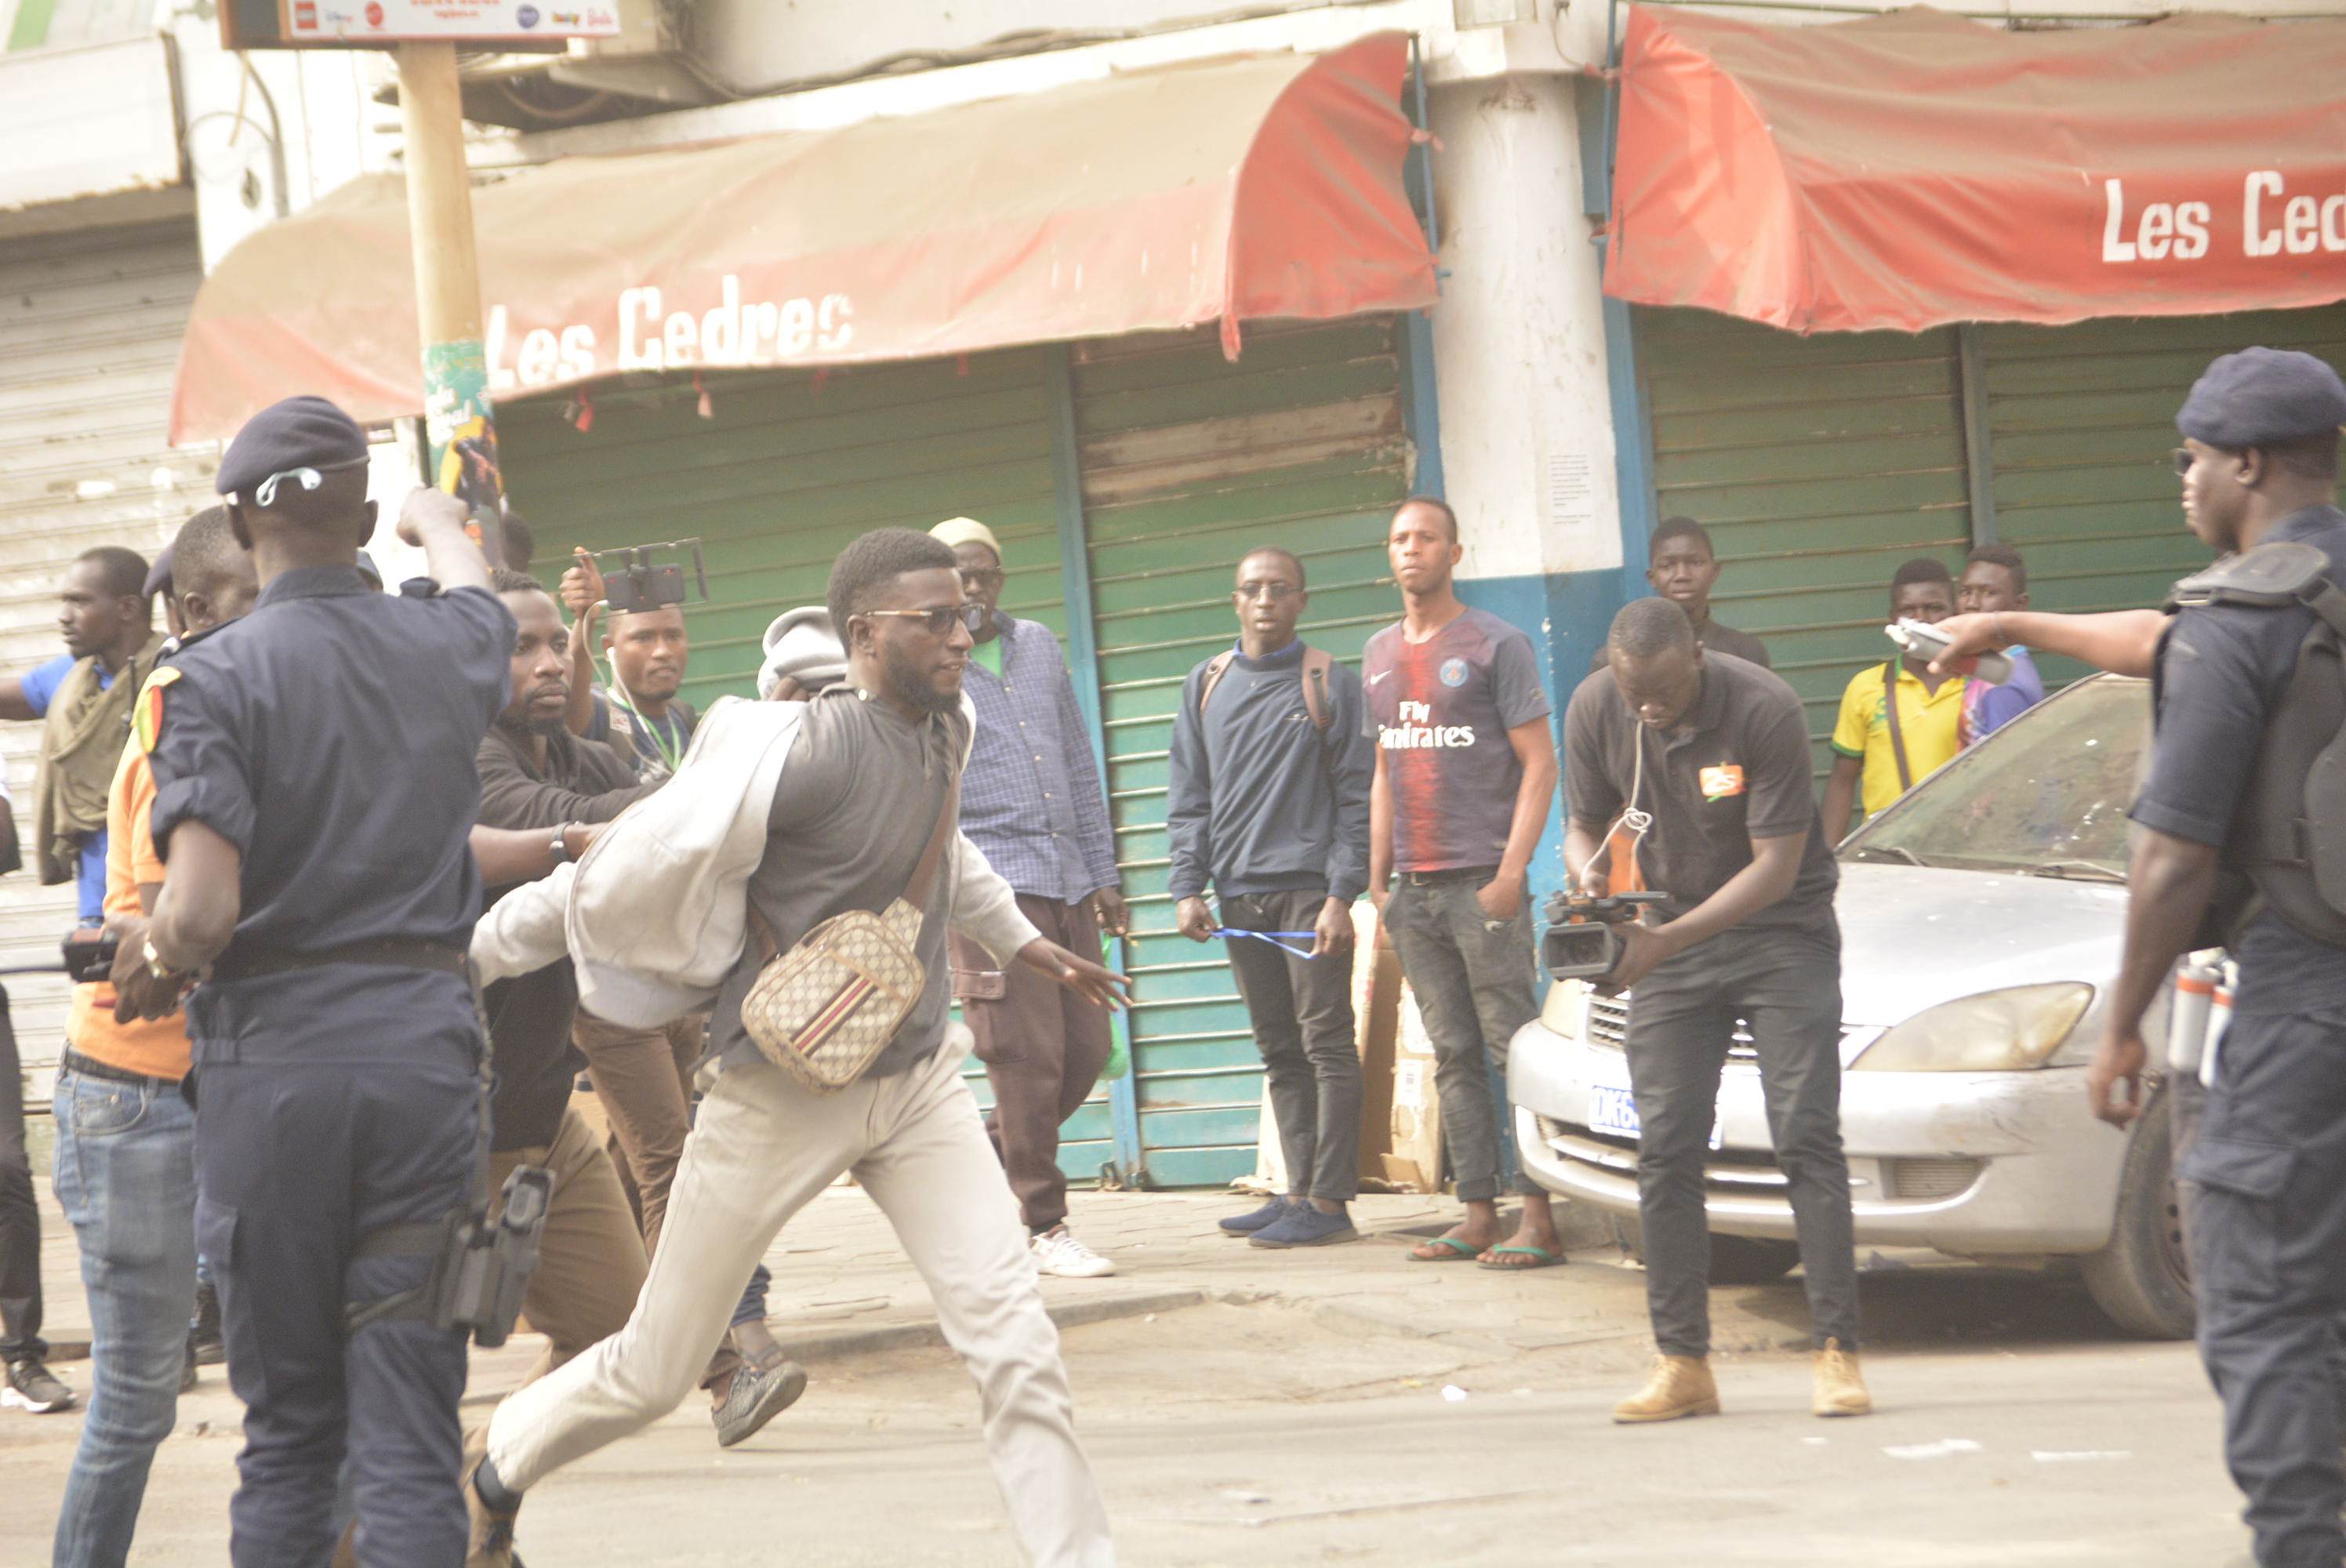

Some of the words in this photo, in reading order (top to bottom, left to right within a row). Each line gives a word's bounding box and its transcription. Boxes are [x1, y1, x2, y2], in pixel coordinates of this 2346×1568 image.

[2102, 177, 2211, 263] Les
[485, 303, 595, 391] Les
[1399, 700, 1431, 724] Fly
